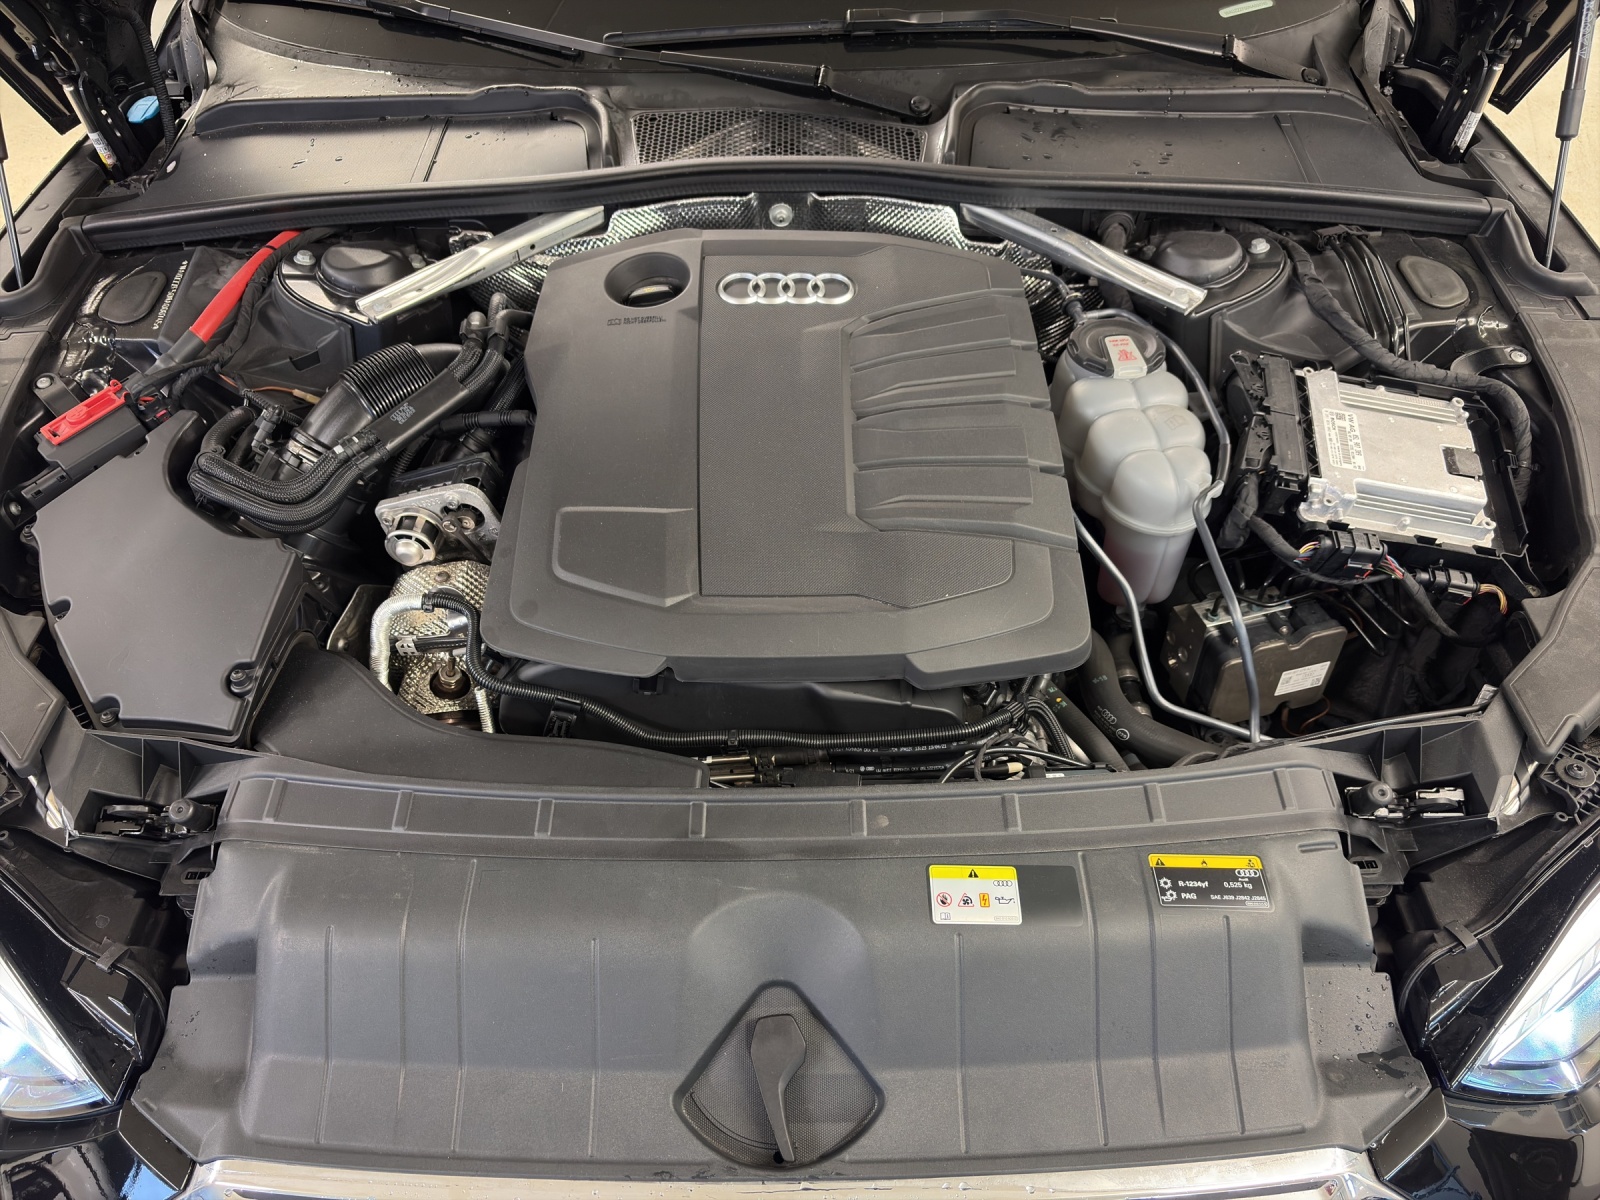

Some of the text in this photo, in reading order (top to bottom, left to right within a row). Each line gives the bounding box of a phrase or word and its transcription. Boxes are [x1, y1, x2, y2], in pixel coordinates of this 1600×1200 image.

[1178, 880, 1253, 889] R-1234yf 0,525 kg
[1181, 892, 1197, 900] PAG
